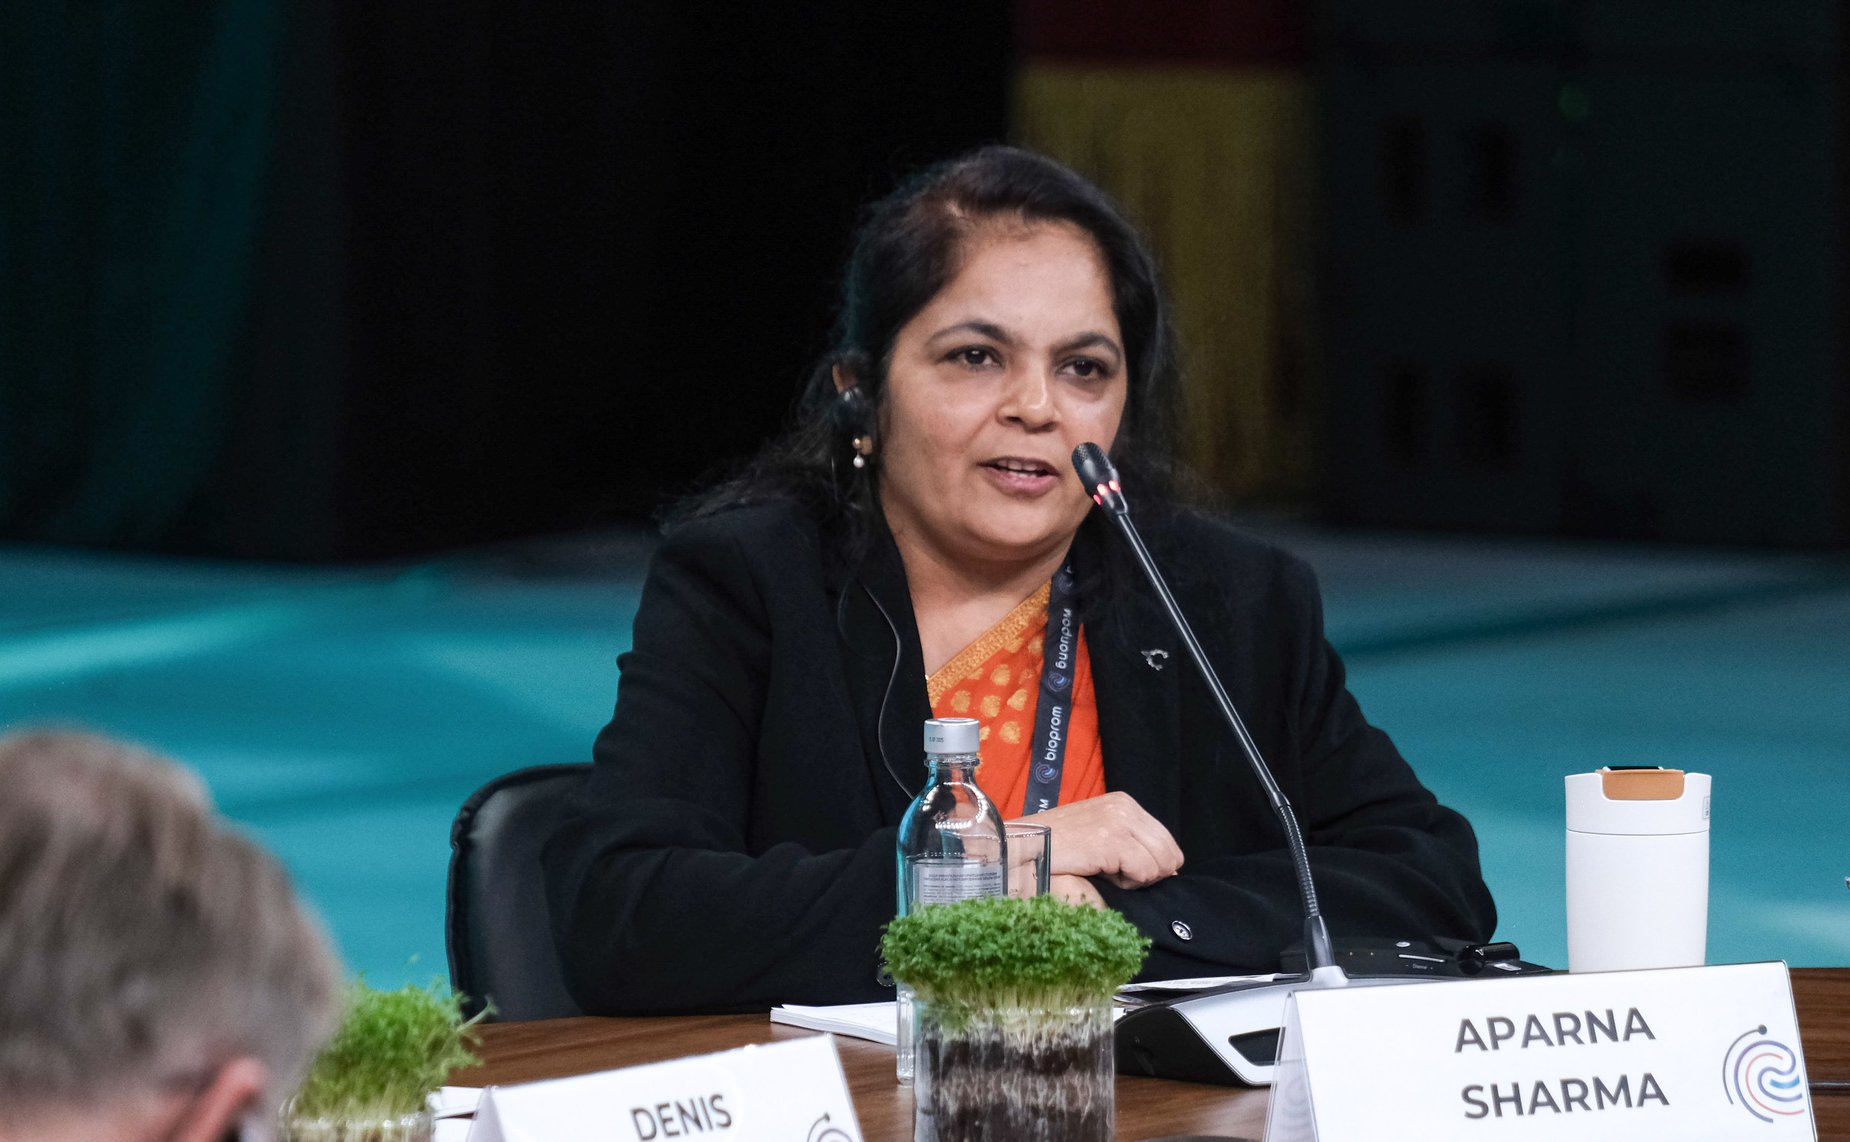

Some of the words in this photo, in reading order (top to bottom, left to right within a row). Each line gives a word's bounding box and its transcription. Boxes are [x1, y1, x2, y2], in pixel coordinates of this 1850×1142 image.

[1044, 706, 1062, 761] bioprom
[1454, 1006, 1656, 1053] APARNA
[630, 1094, 732, 1141] DENIS
[1461, 1072, 1670, 1120] SHARMA
